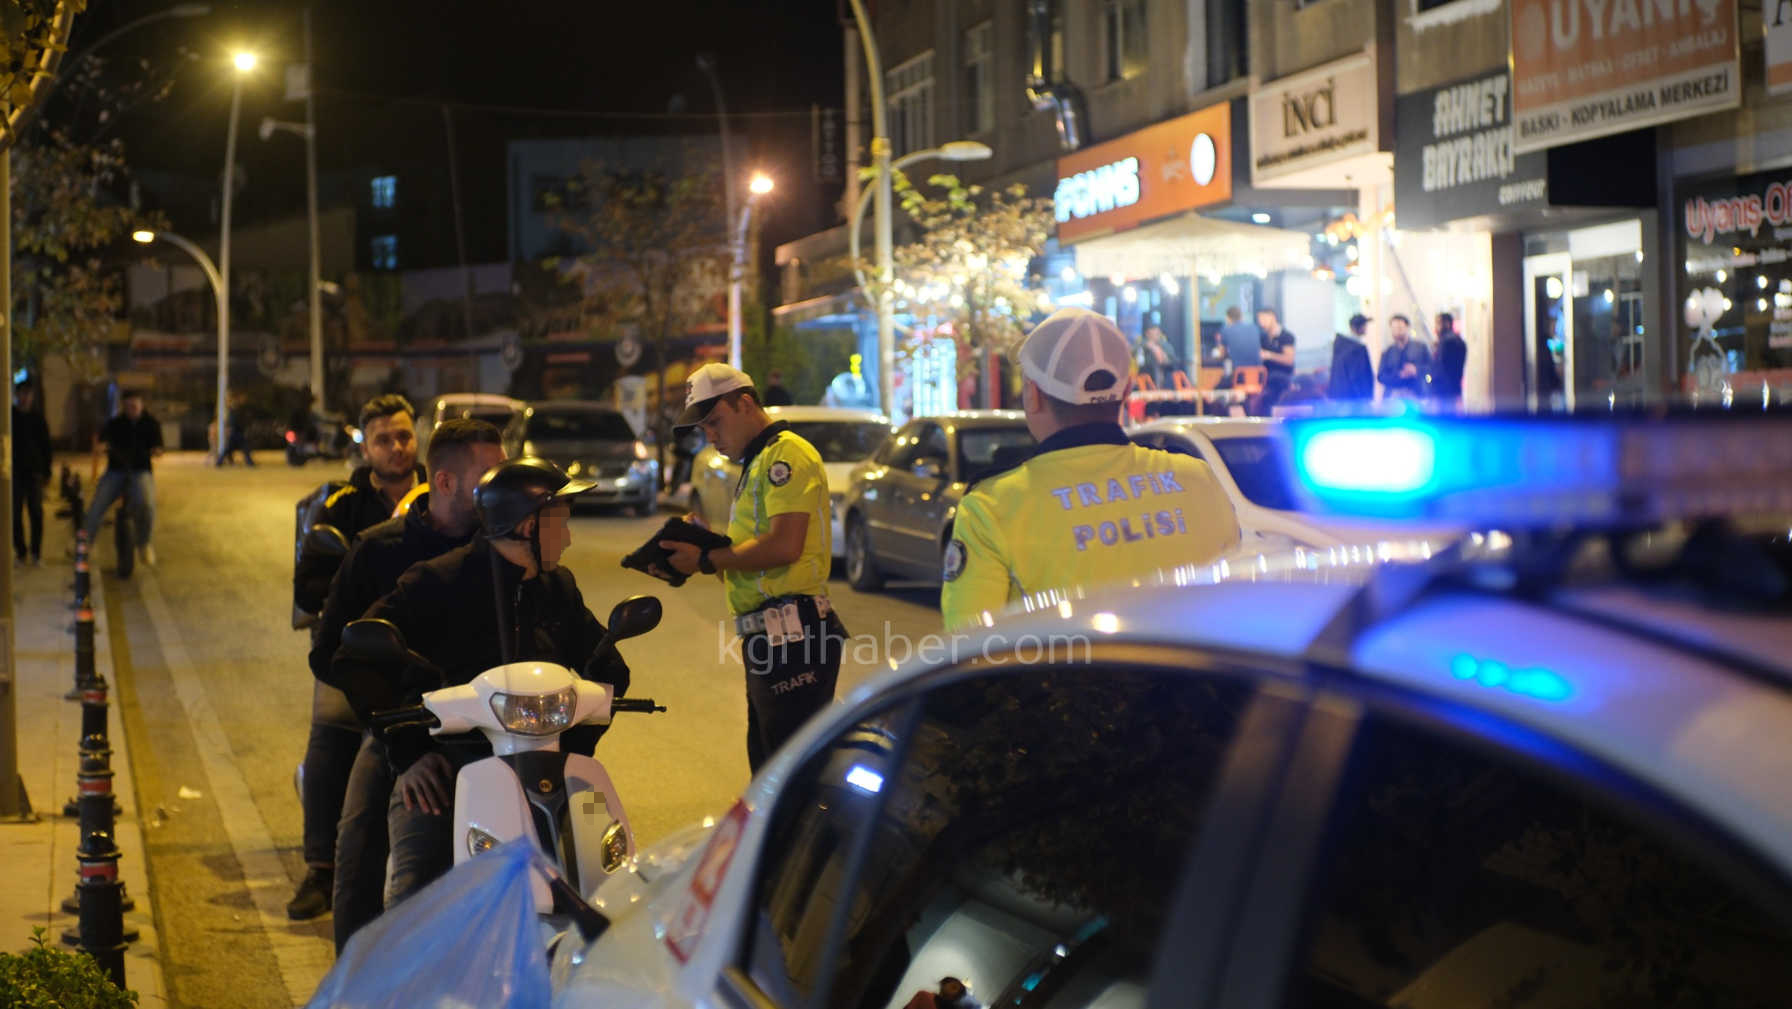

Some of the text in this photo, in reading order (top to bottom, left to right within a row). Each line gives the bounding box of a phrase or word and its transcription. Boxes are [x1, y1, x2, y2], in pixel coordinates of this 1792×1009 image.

[1571, 90, 1657, 128] KOPYALAMA
[1660, 70, 1729, 104] MERKEZİ
[1052, 471, 1185, 511] TRAFİK
[1072, 507, 1187, 551] POLİSİ
